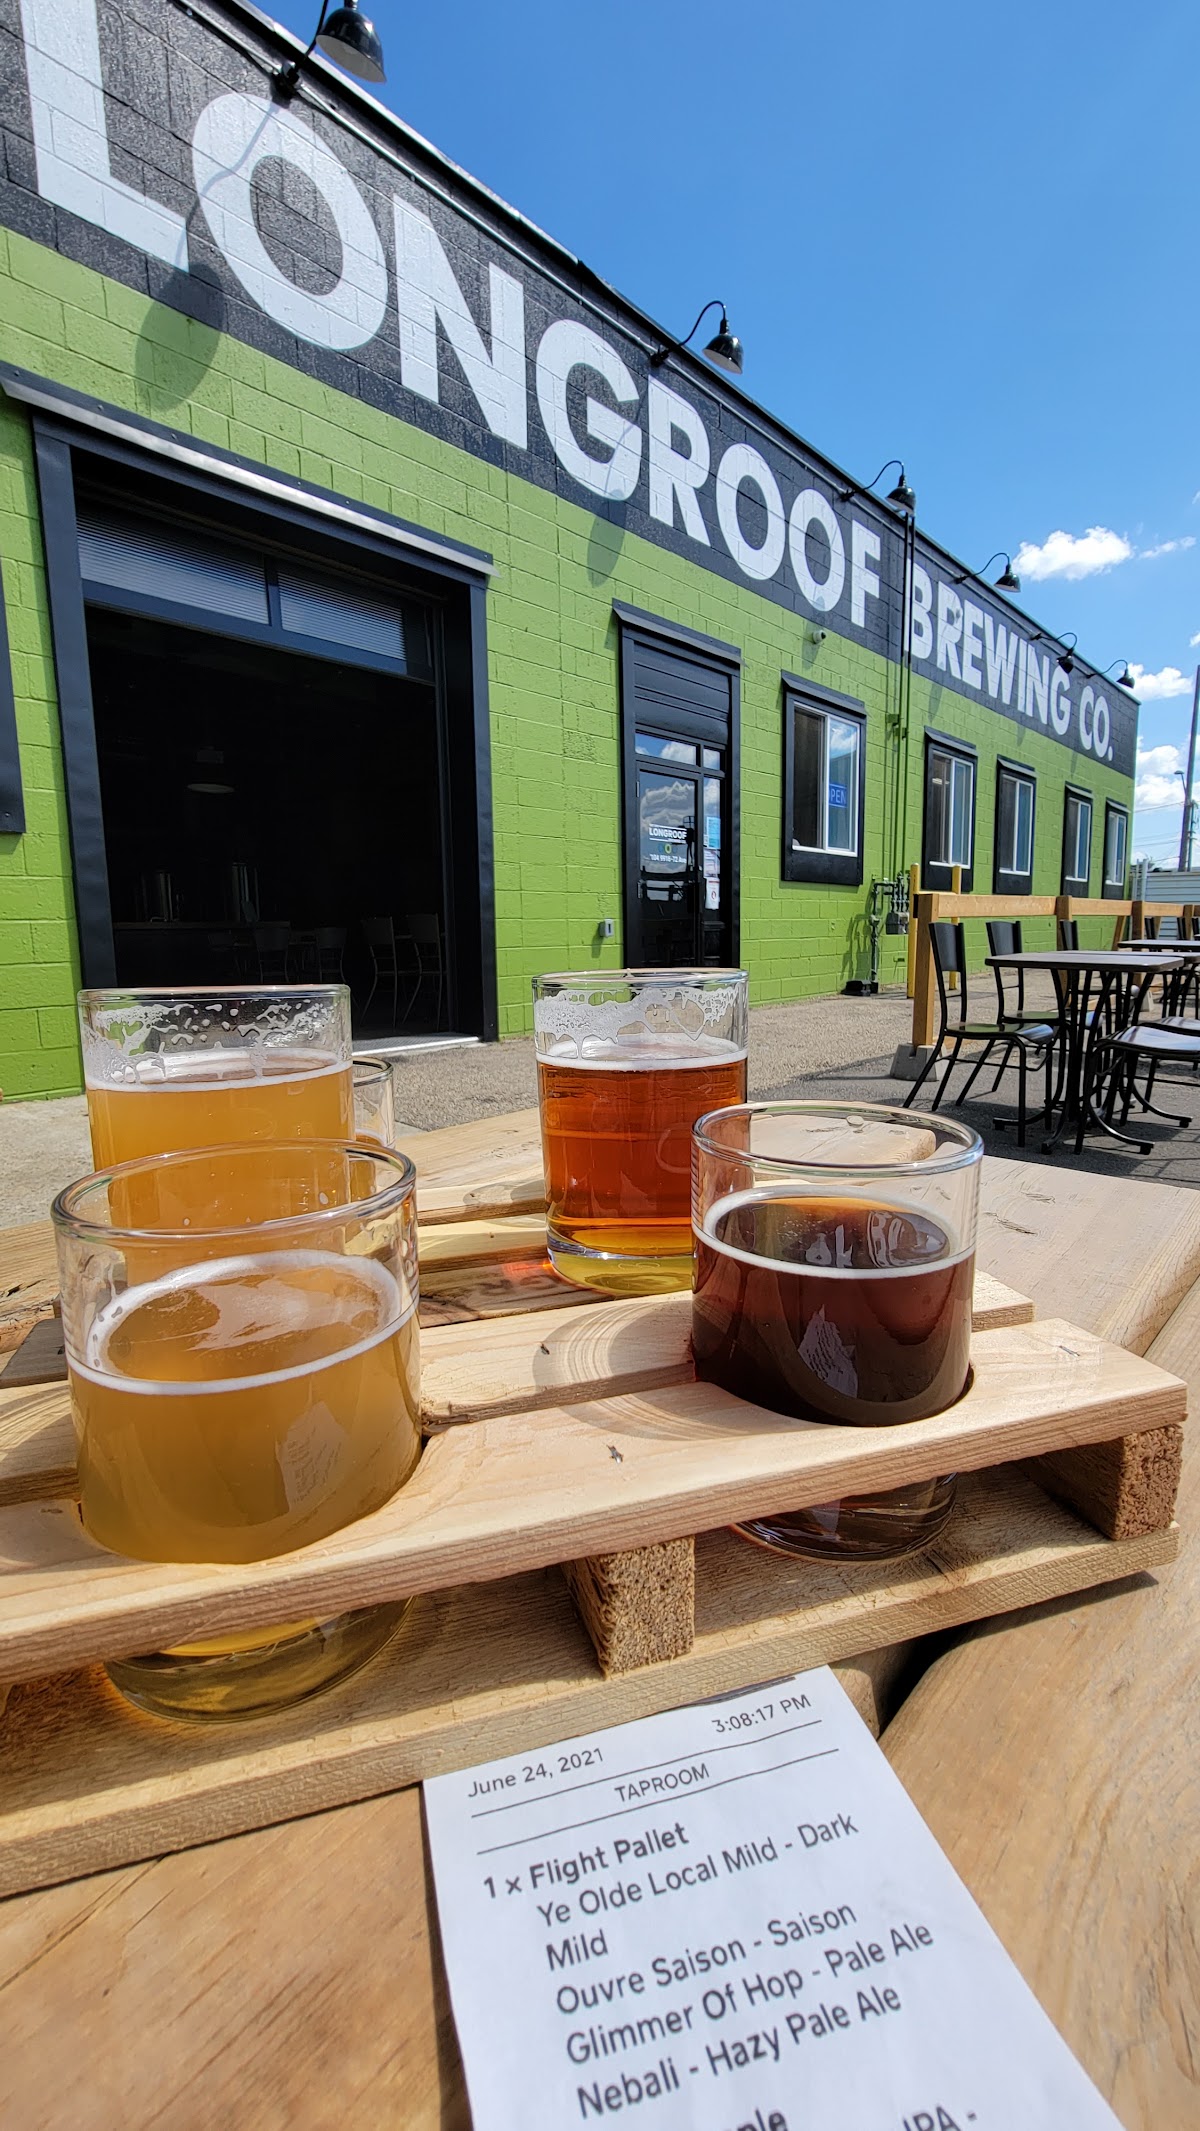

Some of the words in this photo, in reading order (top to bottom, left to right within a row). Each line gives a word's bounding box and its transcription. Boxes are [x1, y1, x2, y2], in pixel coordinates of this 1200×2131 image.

[21, 0, 881, 628] LONGROOF
[904, 556, 1071, 736] BREWING
[1079, 685, 1113, 762] CO.
[829, 788, 847, 805] PEN
[649, 827, 687, 840] LONGROOF
[712, 1704, 774, 1733] 3:08:17
[780, 1694, 812, 1713] PM
[468, 1774, 517, 1797] June
[522, 1763, 553, 1783] 24,
[558, 1748, 603, 1772] 2021
[614, 1763, 710, 1802] TAPROOM
[484, 1876, 496, 1898] 1
[529, 1846, 609, 1889] Flight
[614, 1822, 689, 1864] Pallet
[537, 1902, 571, 1928] Ye
[579, 1881, 642, 1915] Olde
[648, 1854, 718, 1896] Local
[722, 1836, 778, 1874] Mild
[797, 1813, 859, 1848] Dark
[546, 1928, 608, 1972] Mild
[556, 1972, 645, 2014] Ouvre
[651, 1939, 746, 1987] Saison
[767, 1904, 857, 1947] Saison
[566, 2005, 693, 2064] Glimmer
[702, 1983, 737, 2020] Of
[742, 1973, 804, 2006] Hop
[824, 1941, 886, 1979] Pale
[890, 1924, 934, 1957] Ale
[577, 2057, 680, 2120] Nebali
[689, 2066, 699, 2074] -
[705, 2026, 780, 2077] Hazy
[785, 2003, 851, 2045] Pale
[856, 1985, 902, 2022] Ale
